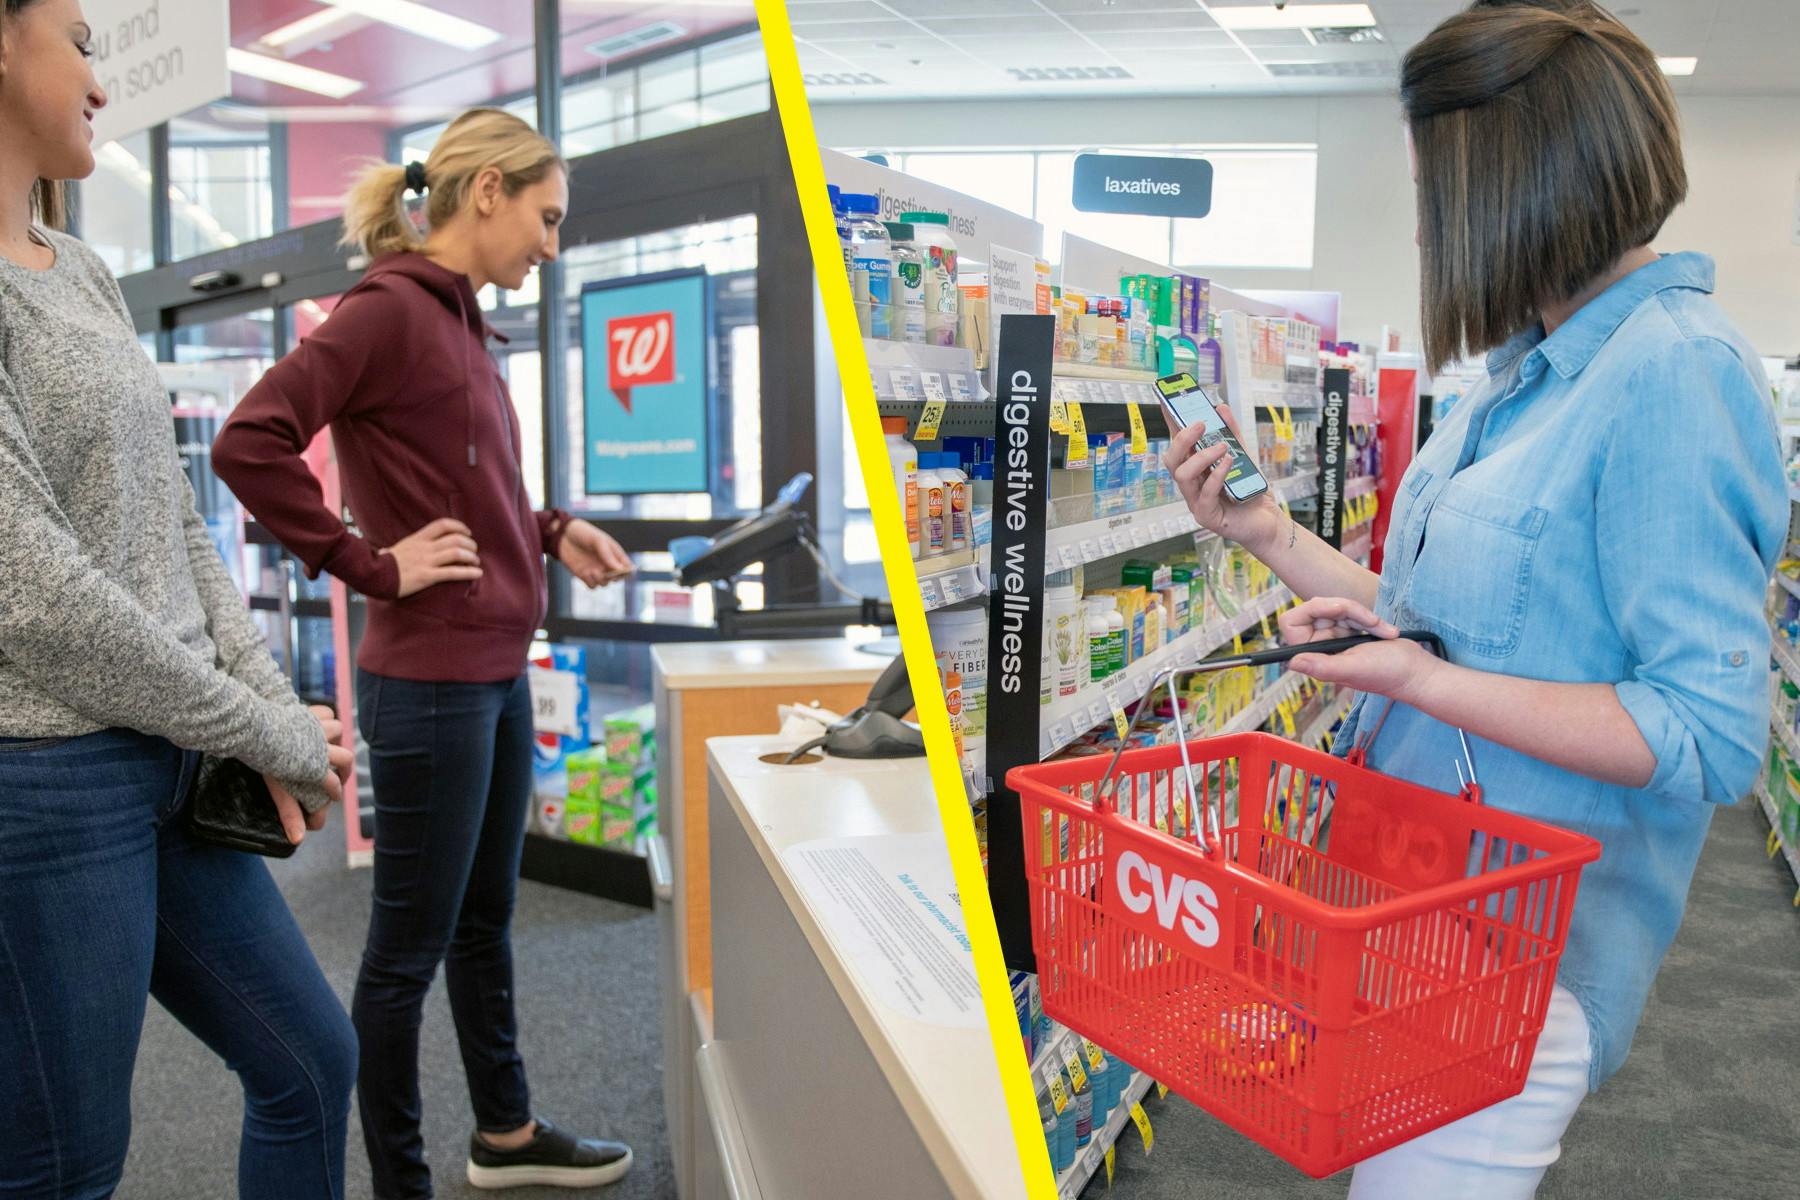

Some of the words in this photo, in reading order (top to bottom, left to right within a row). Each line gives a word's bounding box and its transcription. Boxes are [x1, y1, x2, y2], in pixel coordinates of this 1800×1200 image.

[117, 1, 160, 53] and
[126, 46, 183, 99] soon
[1105, 176, 1181, 195] laxatives
[612, 318, 670, 377] W
[923, 407, 937, 423] 25
[1325, 391, 1343, 465] digestive
[1003, 369, 1037, 531] digestive
[1322, 469, 1342, 538] wellness
[1000, 543, 1031, 694] wellness
[953, 659, 986, 673] FIBER
[1116, 850, 1220, 948] CVS
